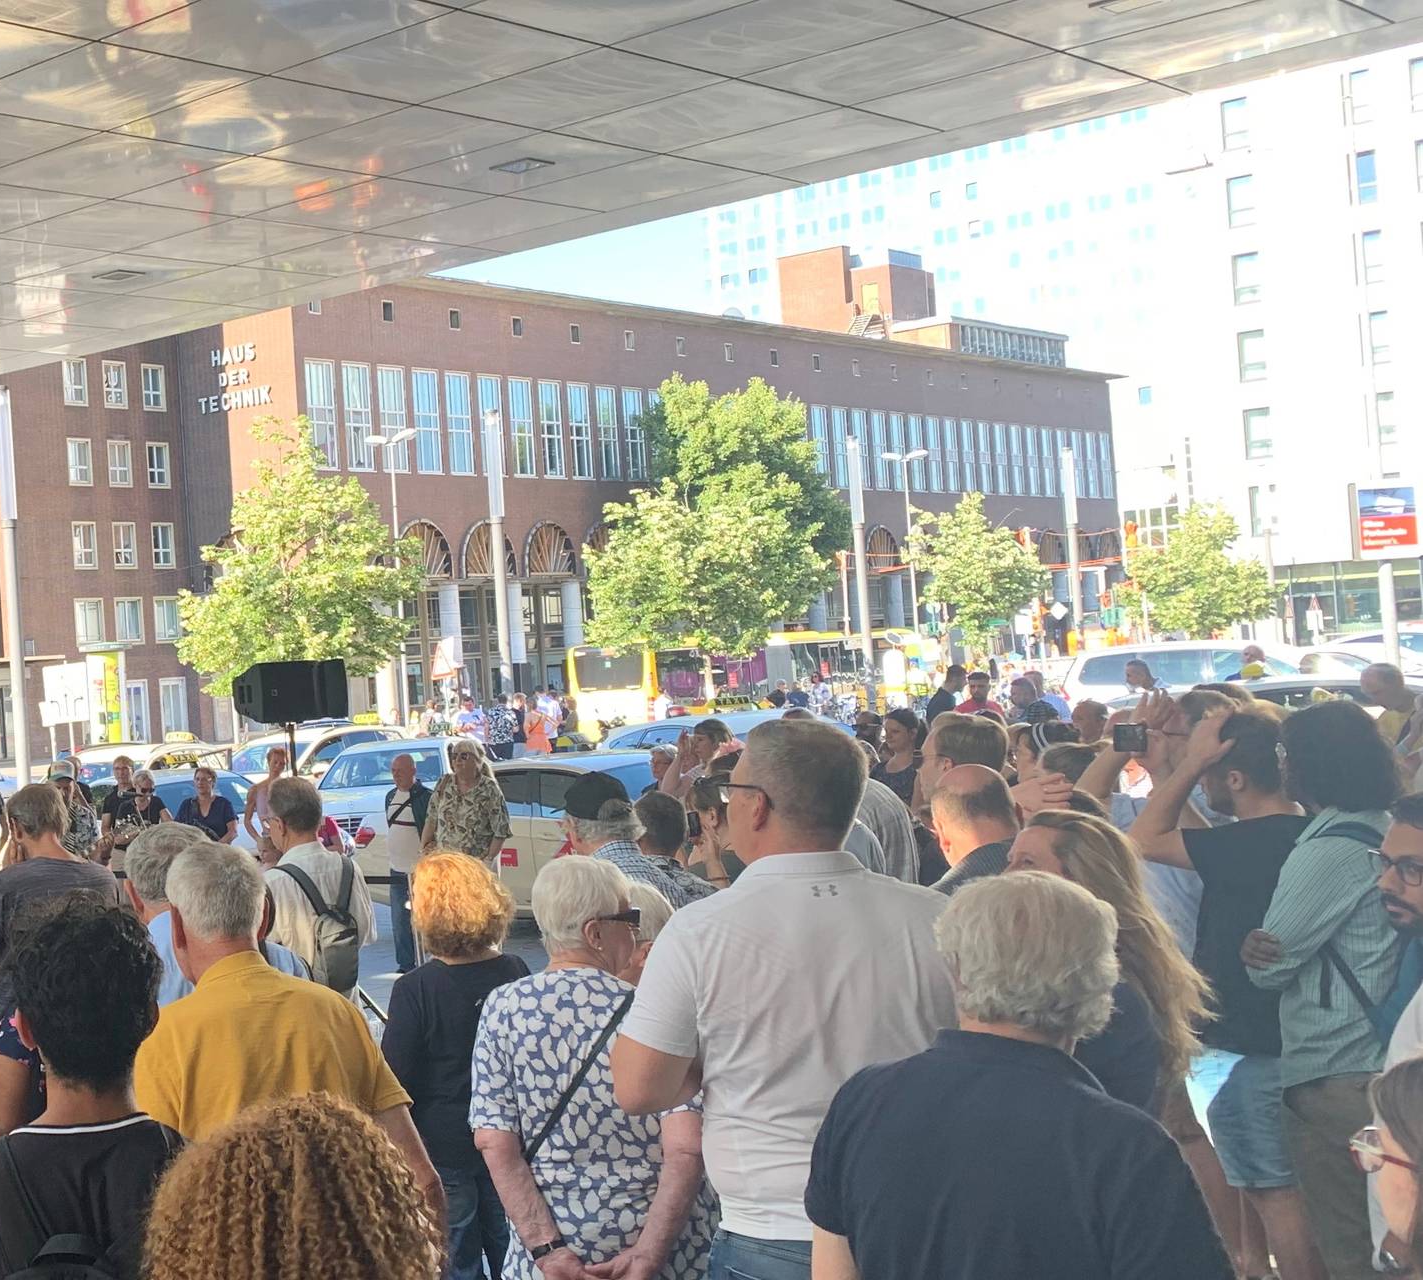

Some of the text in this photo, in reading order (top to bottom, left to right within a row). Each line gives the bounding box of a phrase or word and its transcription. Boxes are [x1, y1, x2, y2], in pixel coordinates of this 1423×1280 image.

[211, 343, 257, 367] HAUS
[218, 368, 250, 388] DER
[198, 384, 273, 415] TECHNIK
